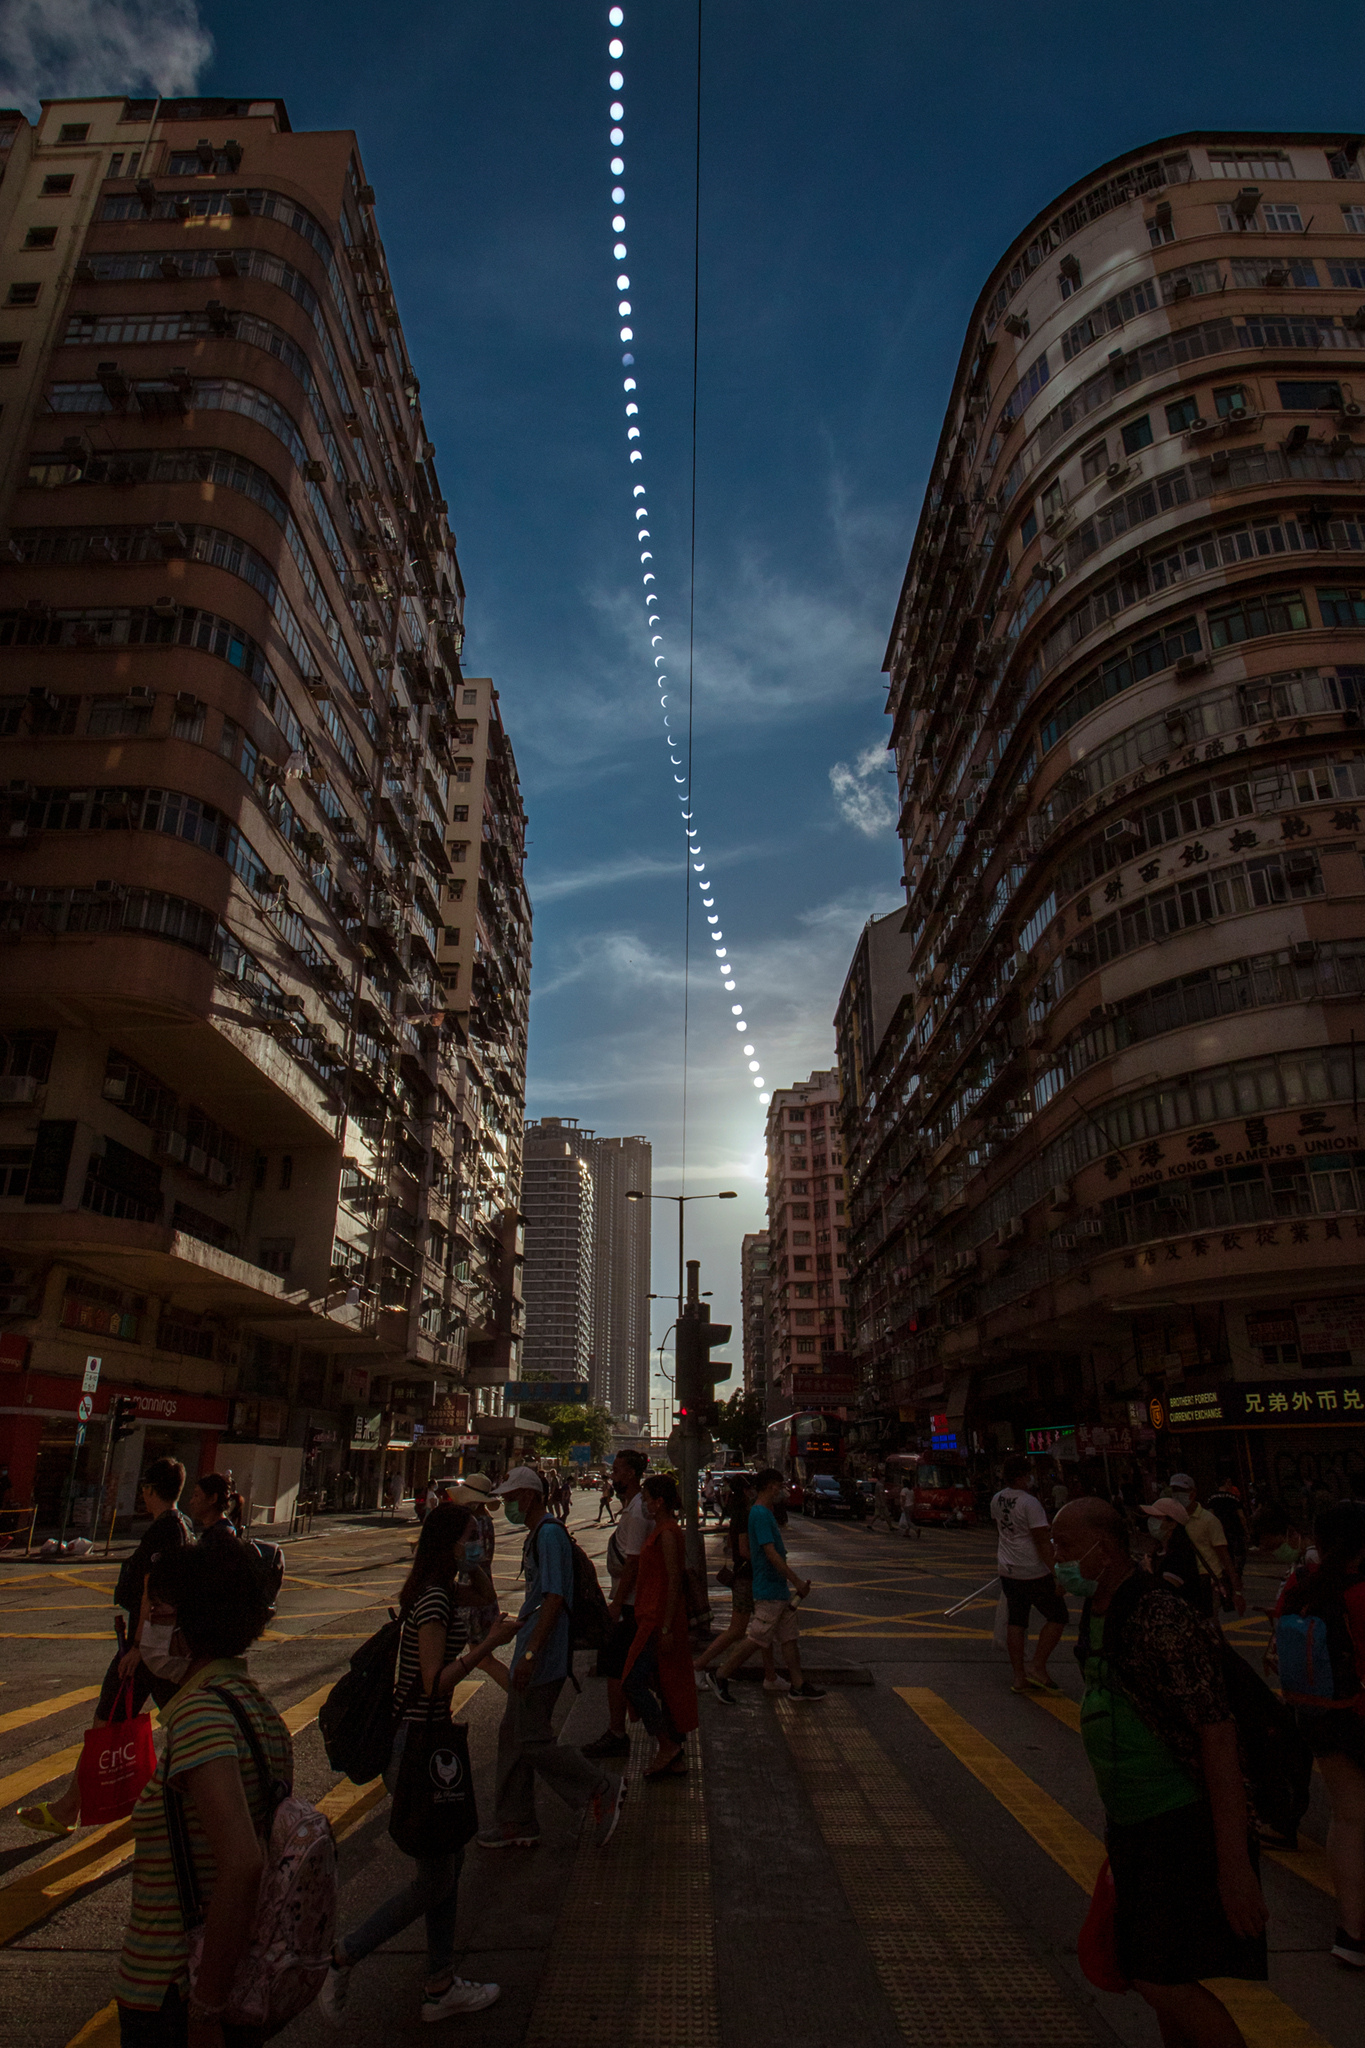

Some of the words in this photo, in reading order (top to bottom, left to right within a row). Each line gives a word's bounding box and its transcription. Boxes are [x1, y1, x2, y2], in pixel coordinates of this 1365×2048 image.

[1130, 1169, 1163, 1188] HONG
[1168, 1159, 1207, 1177] KONG
[1214, 1143, 1296, 1167] SEAMEN'S
[1304, 1136, 1359, 1153] UNION
[1169, 1395, 1194, 1408] BROTHERS
[1194, 1392, 1218, 1404] FOREIGN
[1245, 1389, 1365, 1413] 兄弟外币兑
[1169, 1410, 1195, 1423] CURRENCY
[1194, 1407, 1223, 1421] EXCHANGE
